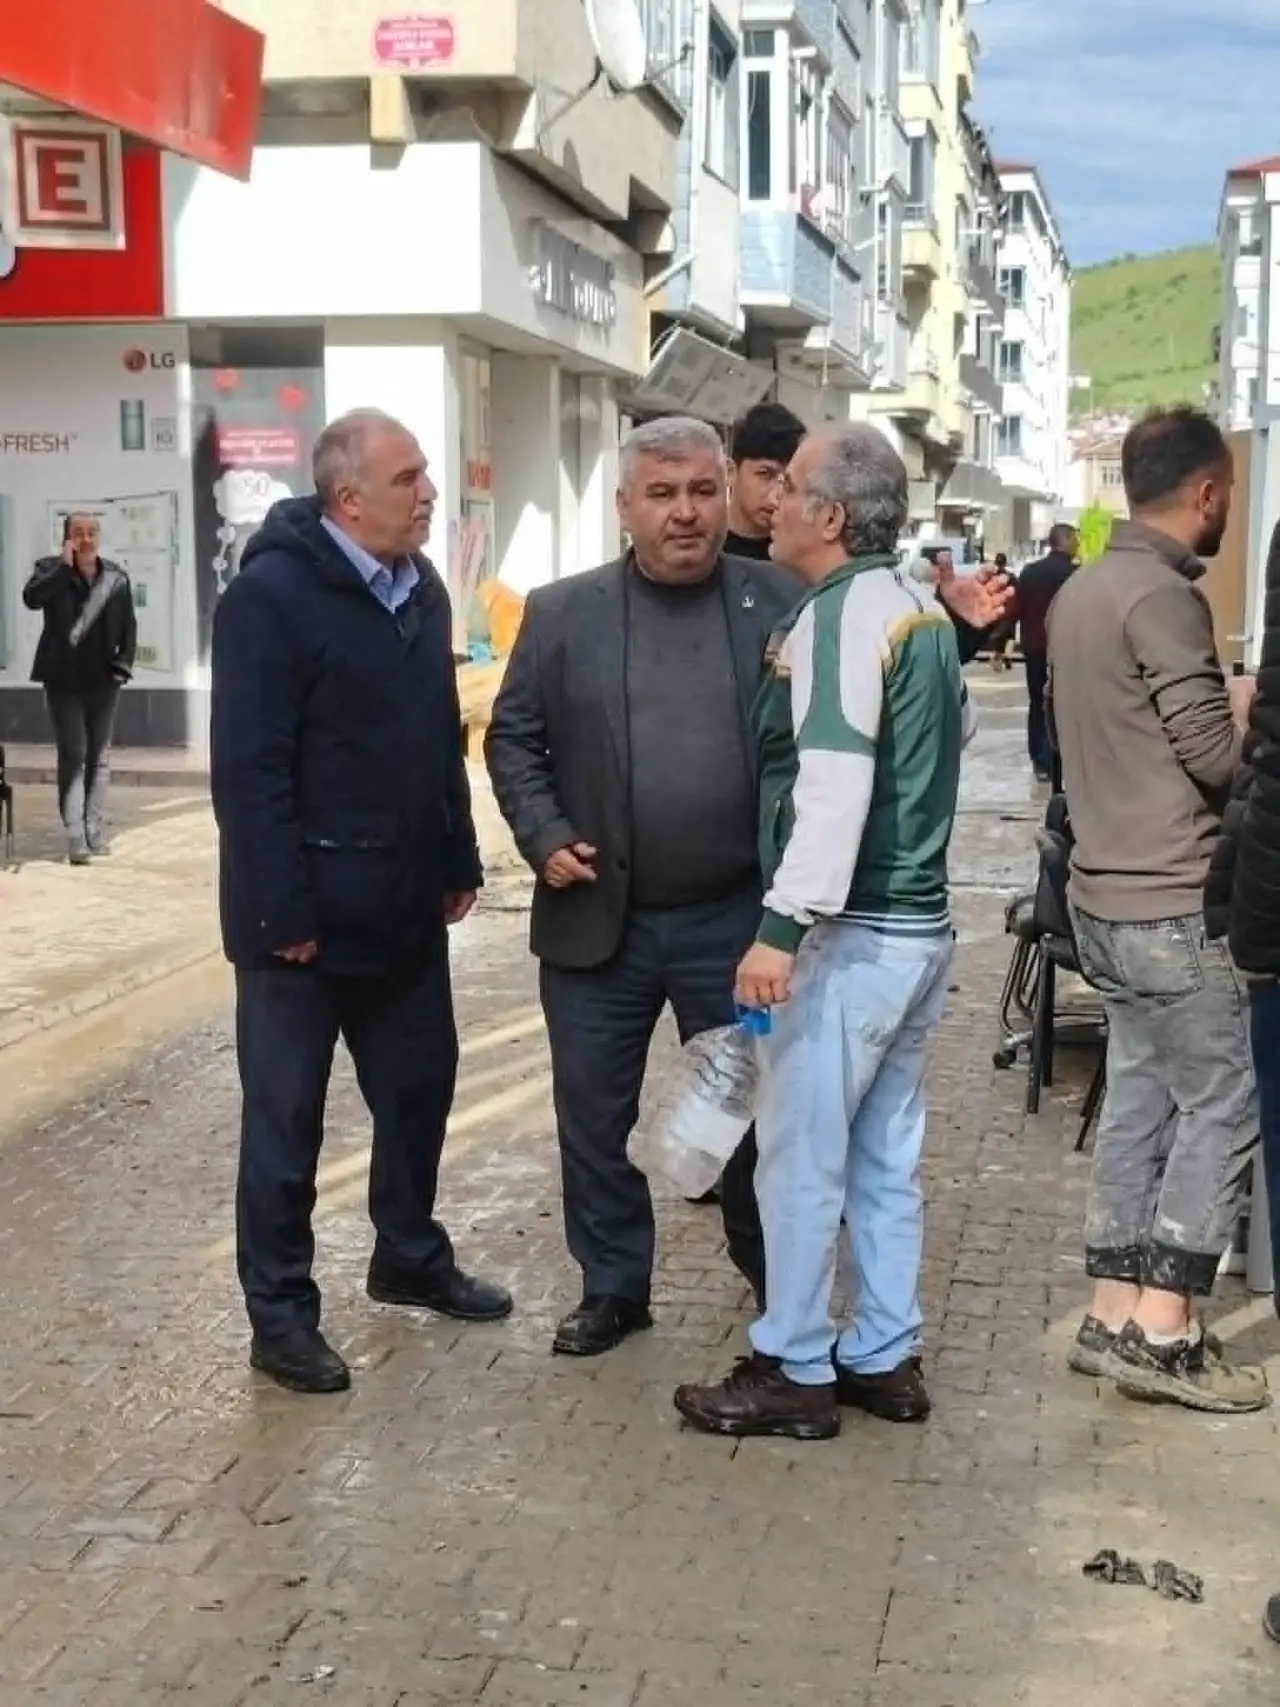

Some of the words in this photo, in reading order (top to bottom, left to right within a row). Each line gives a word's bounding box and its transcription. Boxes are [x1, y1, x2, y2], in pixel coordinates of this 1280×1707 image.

[36, 147, 88, 214] E
[150, 352, 176, 369] LG
[0, 432, 70, 455] FRESH
